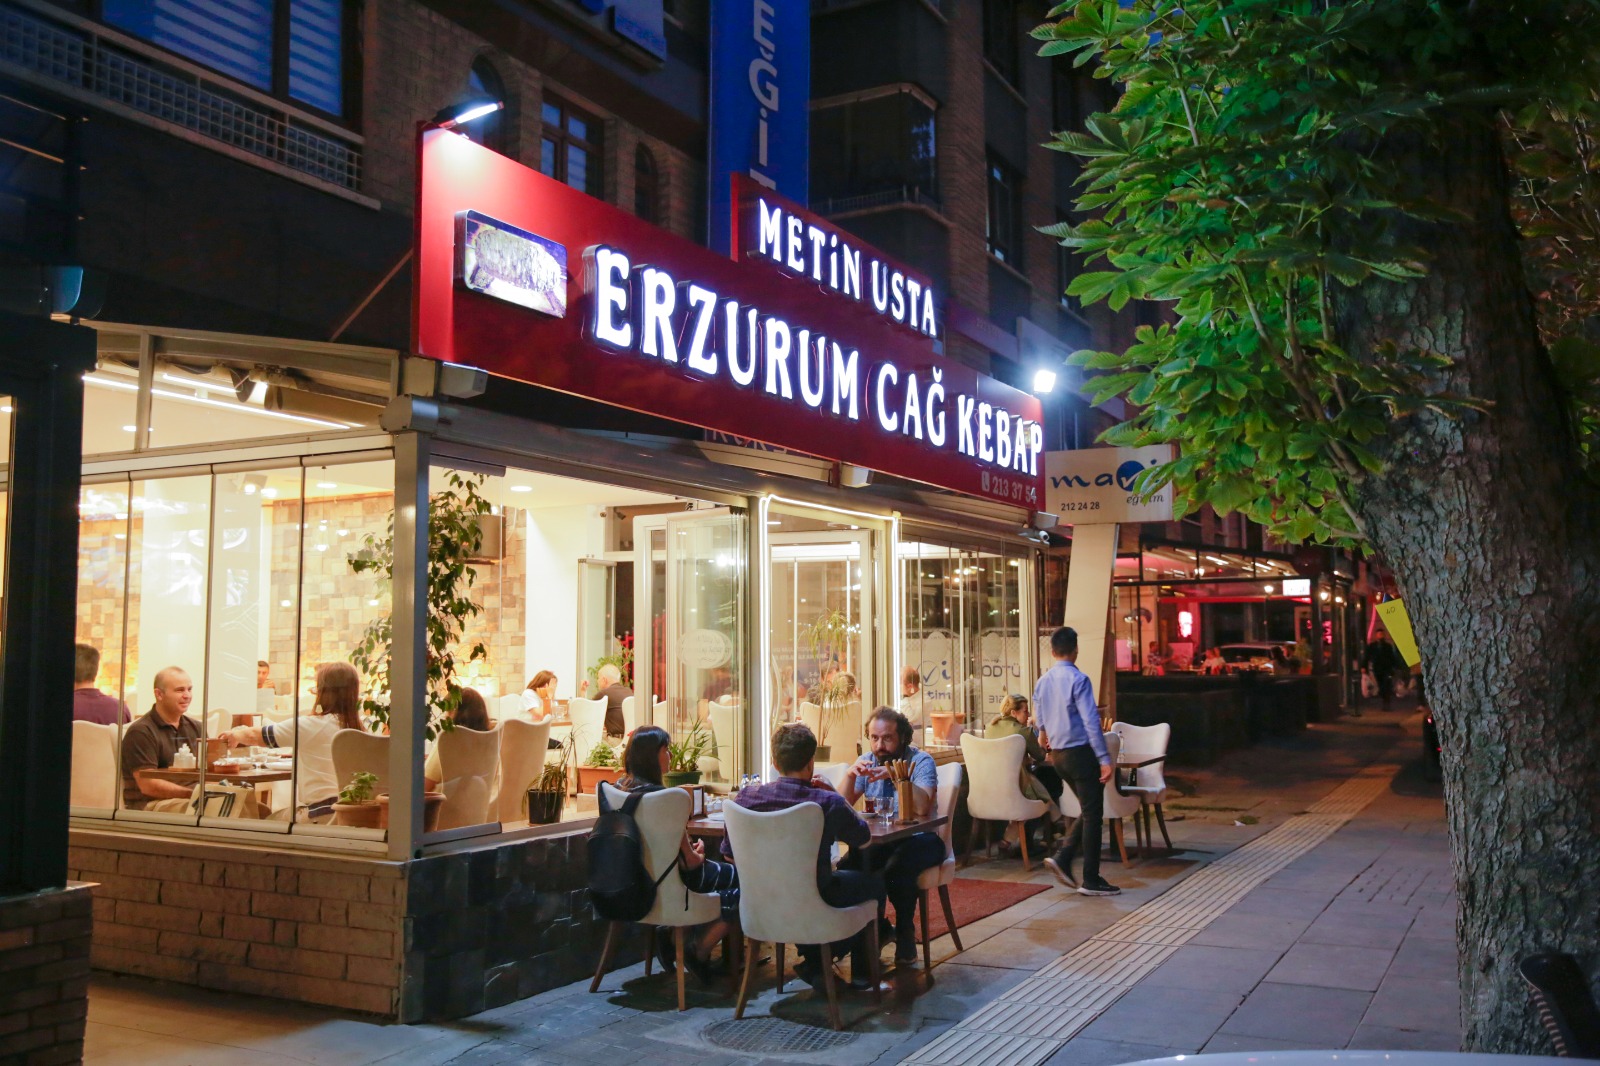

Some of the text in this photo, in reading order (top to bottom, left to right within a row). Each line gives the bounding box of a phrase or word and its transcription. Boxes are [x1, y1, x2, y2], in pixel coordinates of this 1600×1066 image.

[871, 259, 937, 337] USTA
[594, 246, 1044, 477] ERZURUM CAĞ KEBAP
[992, 476, 1037, 505] 213 37 54
[1061, 501, 1101, 511] 212 24 28
